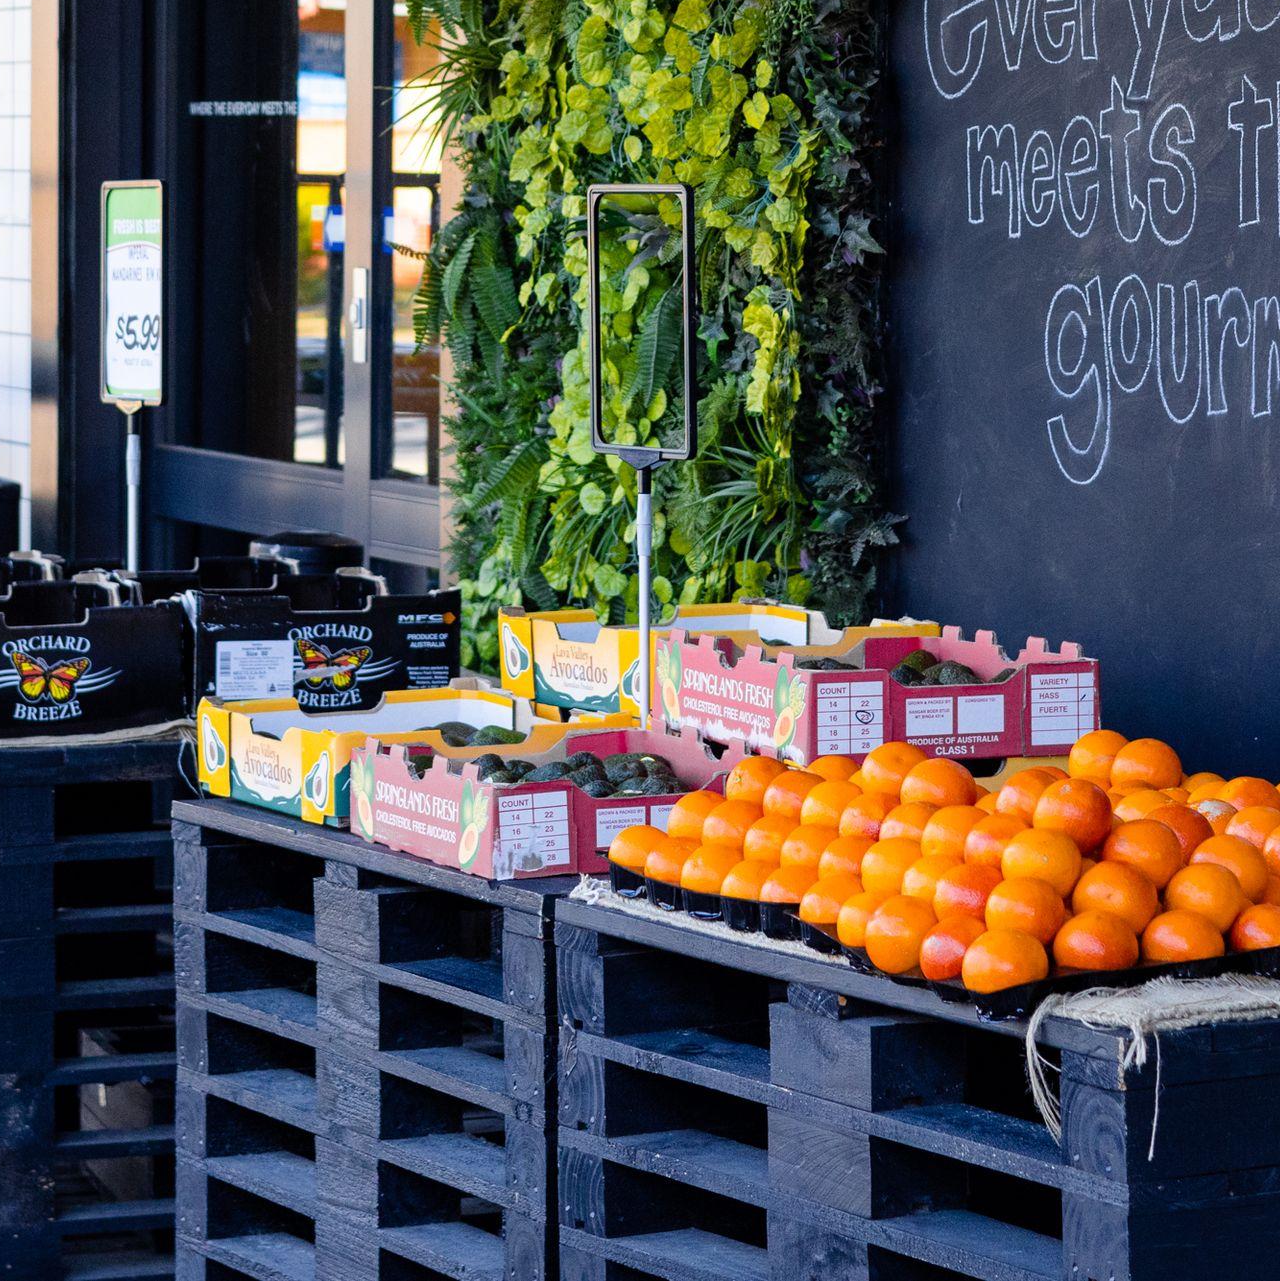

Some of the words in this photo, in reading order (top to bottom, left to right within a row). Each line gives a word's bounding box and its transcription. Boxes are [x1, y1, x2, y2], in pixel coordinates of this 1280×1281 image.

[966, 75, 1198, 247] meets
[116, 313, 161, 351] $5.99
[286, 623, 373, 642] ORCHARD
[438, 632, 449, 640] OF
[1, 635, 91, 657] ORCHARD
[409, 640, 446, 648] AUSTRALIA
[549, 652, 608, 684] Avocados
[296, 688, 362, 707] BREEZE
[683, 668, 743, 702] SPRINGLANDS
[745, 682, 774, 709] FRESH
[13, 700, 82, 721] BREEZE
[683, 696, 721, 717] CHOLESTEROL
[723, 706, 739, 721] FREE
[907, 737, 944, 746] PRODUCE
[945, 736, 955, 744] OF
[957, 735, 999, 743] AUSTRALIA
[935, 745, 967, 755] CLASS
[970, 745, 975, 753] 1
[243, 749, 292, 785] Avocados
[375, 780, 431, 815] SPRINGLANDS
[432, 796, 459, 823] FRESH
[501, 799, 529, 808] COUNT
[375, 809, 412, 831] CHOLESTEROL
[412, 819, 427, 836] FREE
[426, 824, 456, 843] AVOCADOS
[547, 853, 556, 861] 28
